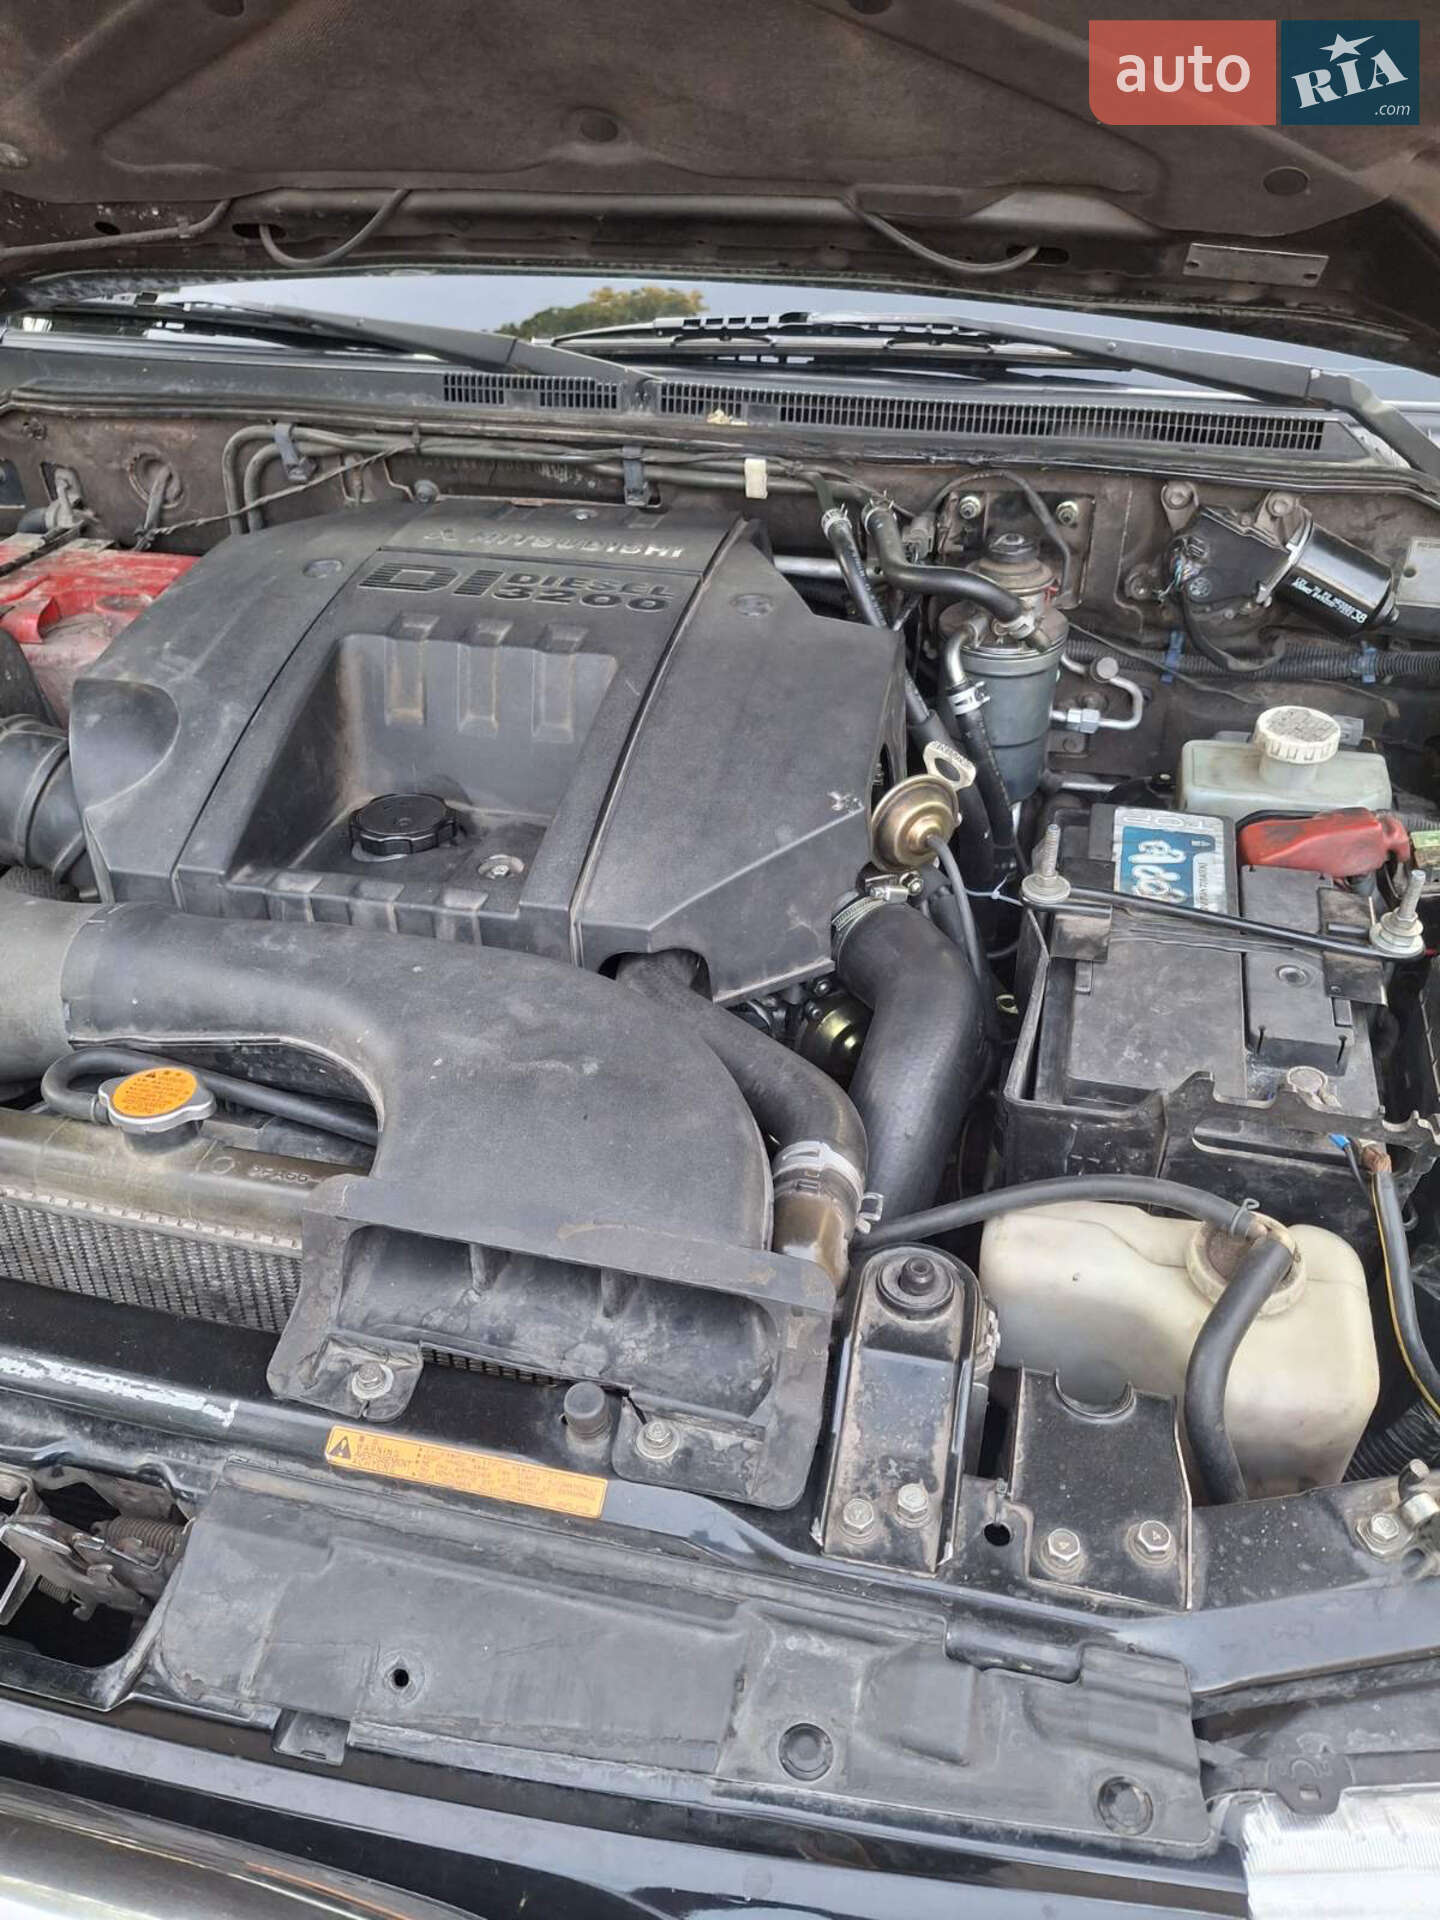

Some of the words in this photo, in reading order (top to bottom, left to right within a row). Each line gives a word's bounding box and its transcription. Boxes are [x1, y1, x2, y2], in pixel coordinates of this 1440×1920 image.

[468, 531, 684, 559] MITSUBISHI
[491, 585, 671, 613] 3200
[505, 573, 676, 599] DIESEL
